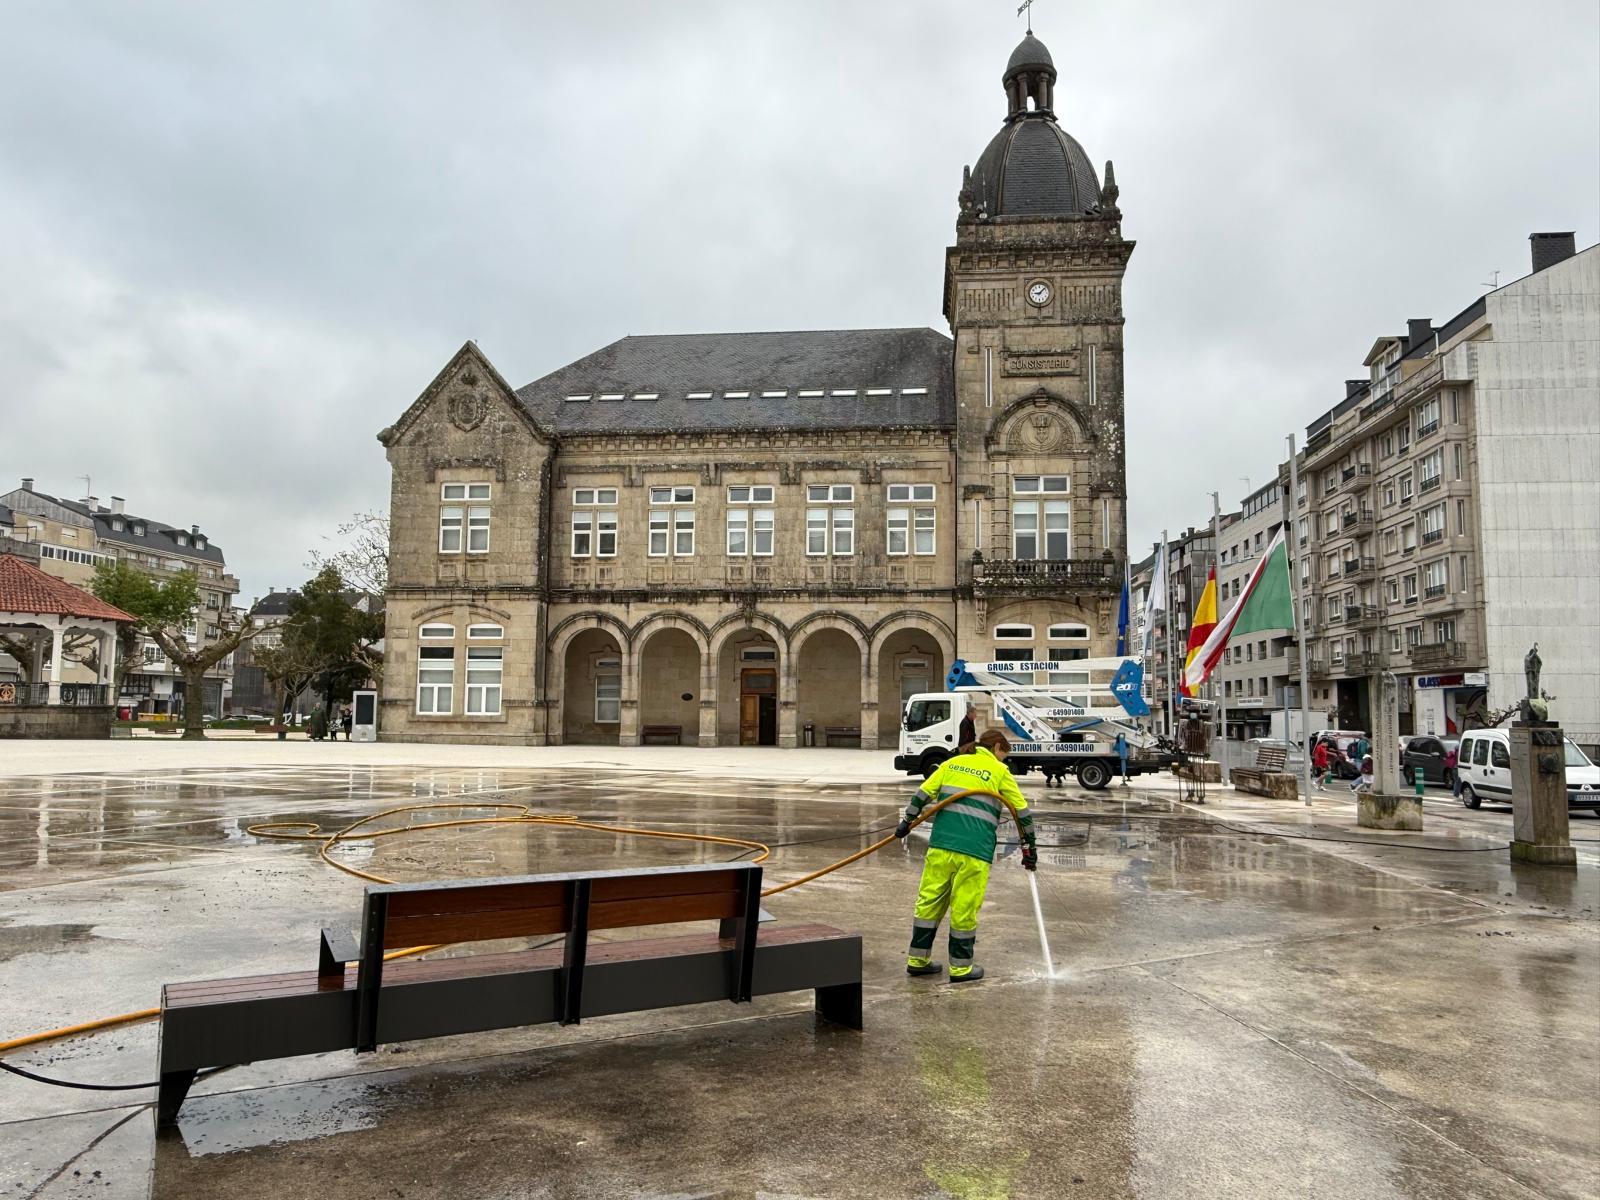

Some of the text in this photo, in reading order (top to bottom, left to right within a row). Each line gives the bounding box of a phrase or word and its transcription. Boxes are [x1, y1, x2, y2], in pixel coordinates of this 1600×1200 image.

[987, 662, 1059, 671] GRUAS ESTACION
[1055, 743, 1094, 752] 649901400
